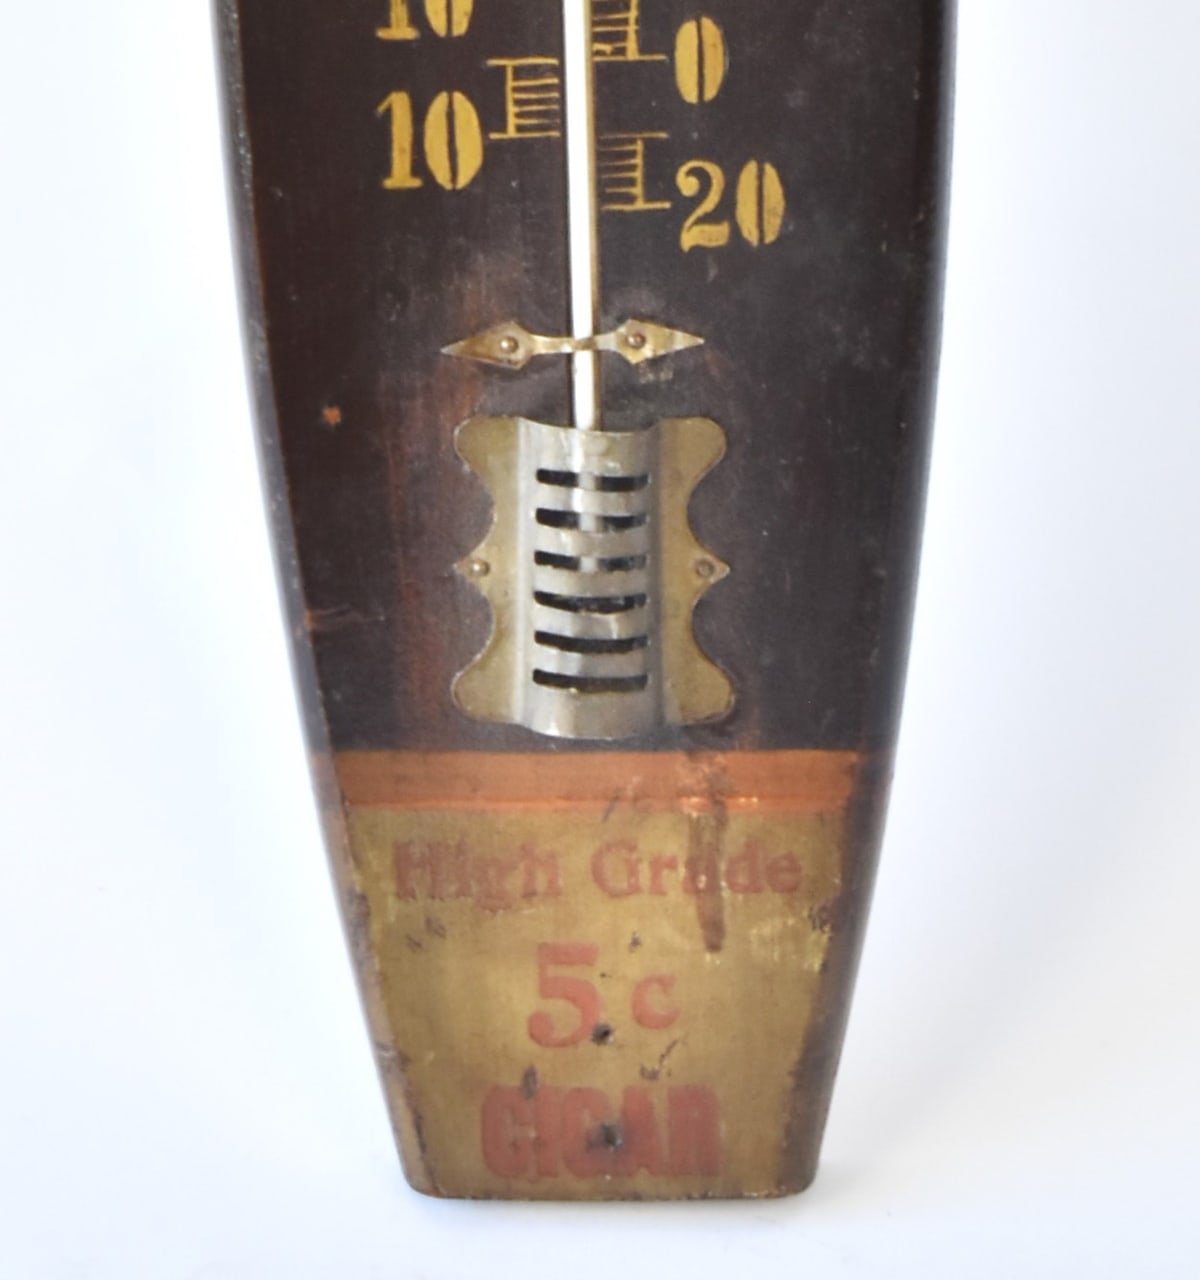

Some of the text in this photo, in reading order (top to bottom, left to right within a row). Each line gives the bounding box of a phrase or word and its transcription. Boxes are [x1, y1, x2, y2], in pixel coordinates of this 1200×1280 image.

[673, 15, 727, 104] 0
[376, 90, 484, 191] 10
[674, 160, 786, 253] 20
[392, 839, 803, 911] High Grade
